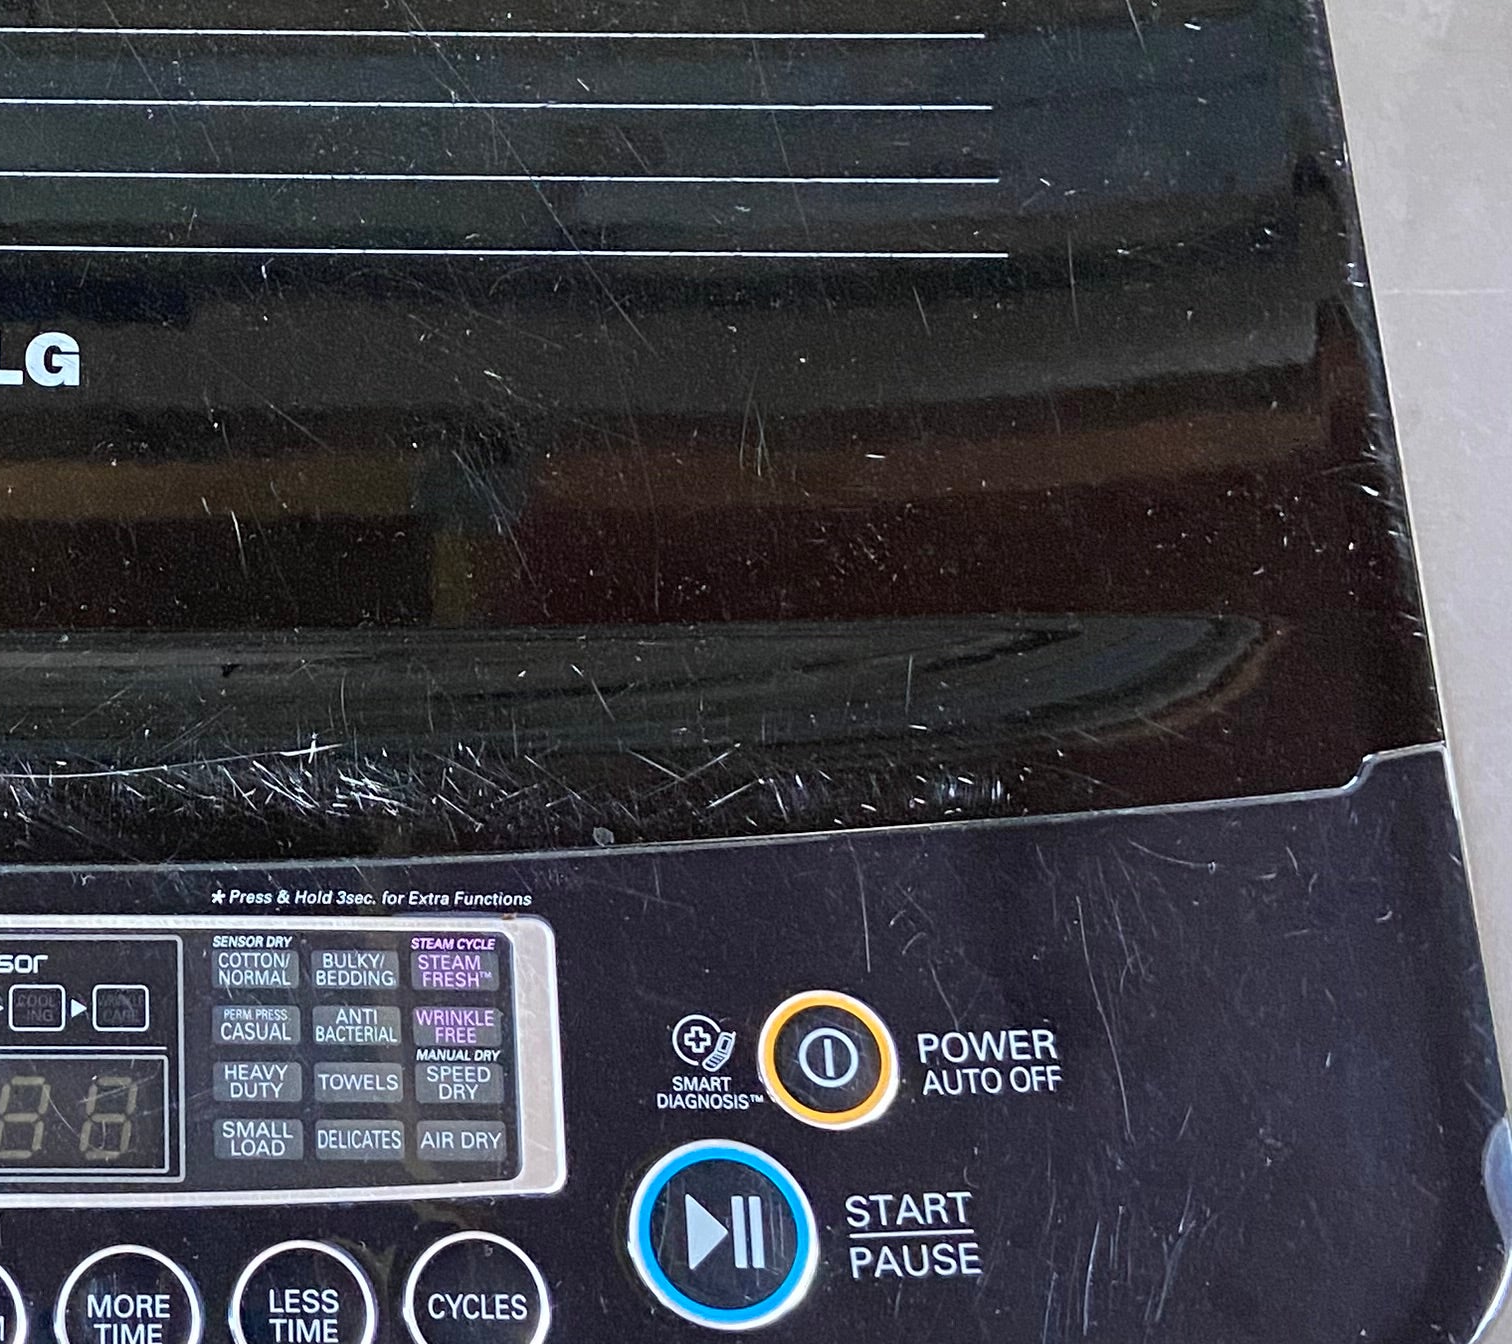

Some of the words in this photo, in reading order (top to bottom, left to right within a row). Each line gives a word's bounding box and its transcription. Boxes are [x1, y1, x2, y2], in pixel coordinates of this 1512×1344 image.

[229, 890, 272, 905] Press
[277, 890, 289, 904] &
[294, 891, 332, 905] Hold
[336, 892, 376, 905] 3sec.
[382, 892, 404, 906] for
[408, 892, 450, 906] Extra
[454, 892, 532, 907] Functions
[212, 936, 263, 947] SENSOR
[265, 936, 292, 947] DRY
[411, 938, 454, 950] STEAM
[458, 939, 495, 951] CYCLE
[218, 954, 289, 969] COTTON/
[323, 954, 384, 969] BULKY/
[418, 955, 481, 970] STEAM
[218, 970, 291, 986] NORMAL
[316, 970, 394, 986] BEDDING
[336, 1009, 378, 1024] ANTI
[416, 1010, 494, 1026] WRINKLE
[221, 1024, 291, 1041] CASUAL
[315, 1026, 398, 1042] BACTERIAL
[435, 1028, 477, 1043] FREE
[918, 1030, 1058, 1063] POWER
[416, 1050, 472, 1061] MANUAL
[474, 1050, 501, 1062] DRY
[224, 1065, 288, 1081] HEAVY
[427, 1066, 491, 1082] SPEED
[923, 1068, 1003, 1096] AUTO
[1009, 1066, 1062, 1092] OFF
[318, 1074, 399, 1090] TOWELS
[672, 1076, 731, 1092] SMART
[230, 1083, 283, 1099] DUTY
[439, 1083, 478, 1100] DRY
[222, 1123, 293, 1138] SMALL
[318, 1130, 401, 1149] DELICATES
[420, 1132, 454, 1149] AIR
[460, 1132, 502, 1149] DRY
[231, 1140, 285, 1156] LOAD
[845, 1192, 972, 1227] START
[849, 1242, 982, 1278] PAUSE
[87, 1294, 170, 1320] MORE
[268, 1289, 339, 1314] LESS
[428, 1294, 527, 1321] CYCLES
[270, 1319, 338, 1344] TIME
